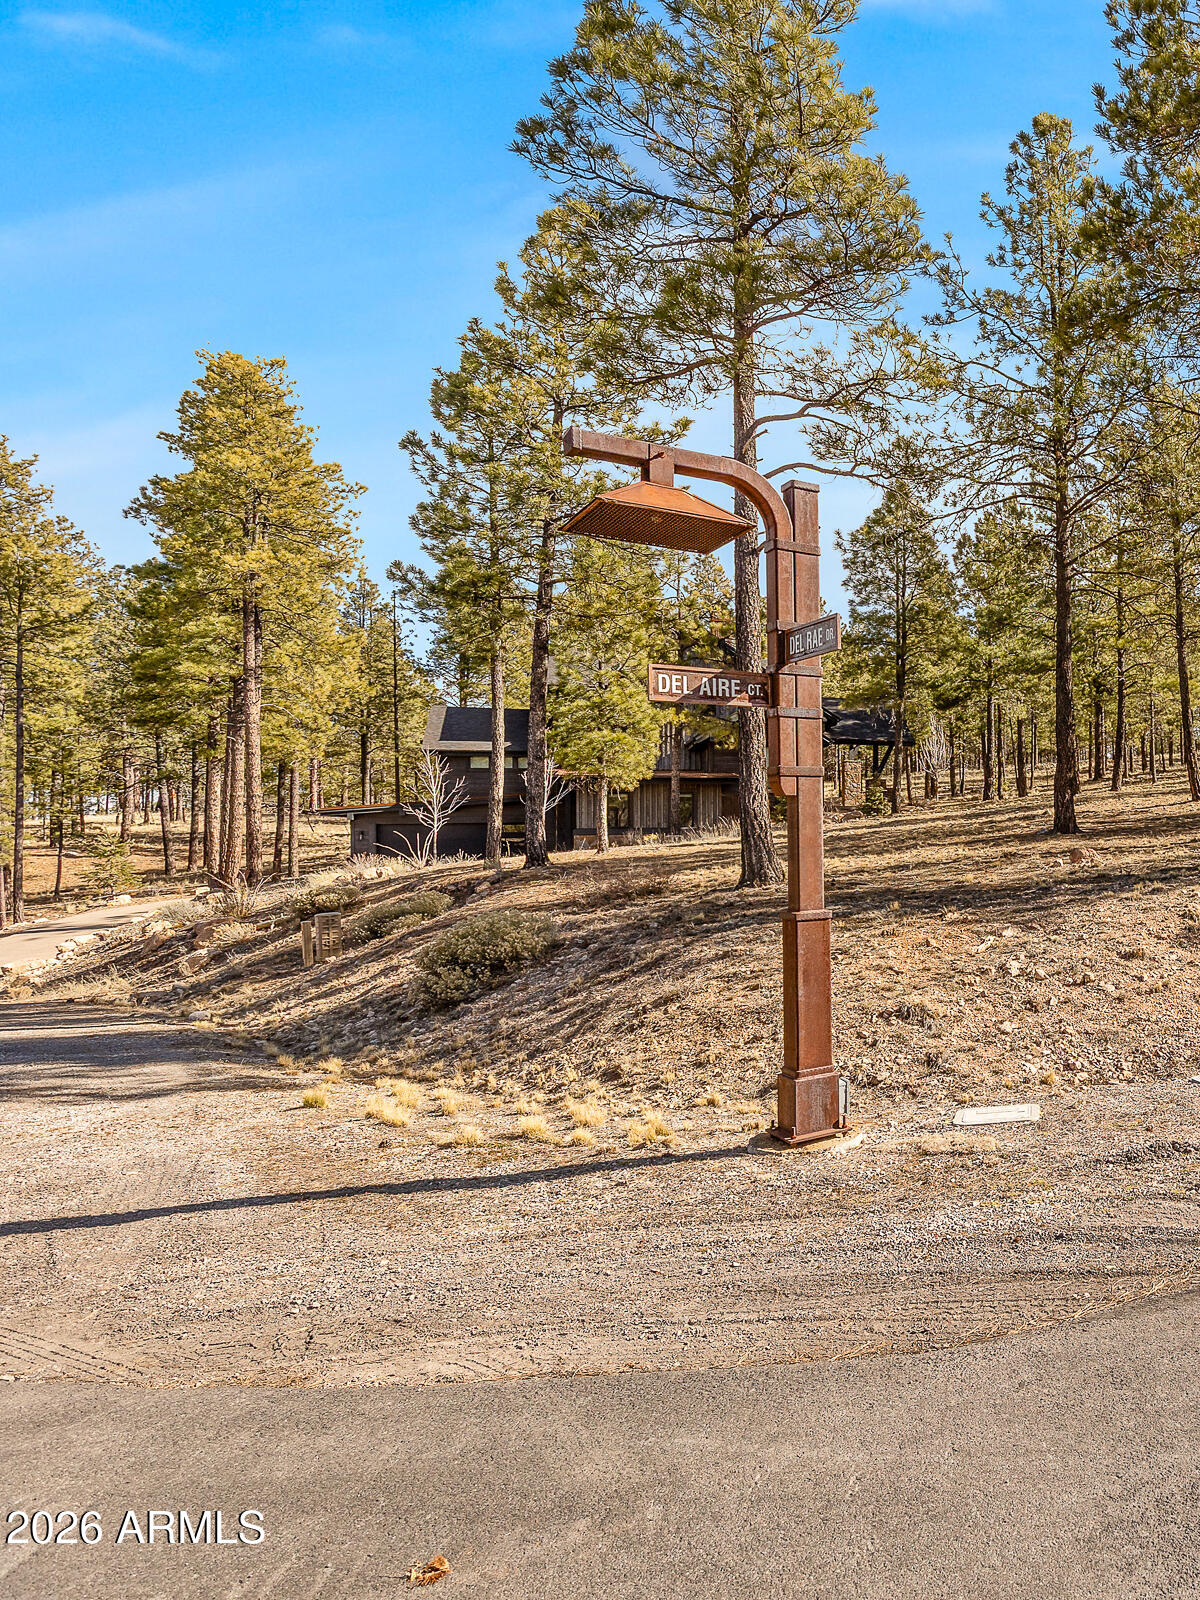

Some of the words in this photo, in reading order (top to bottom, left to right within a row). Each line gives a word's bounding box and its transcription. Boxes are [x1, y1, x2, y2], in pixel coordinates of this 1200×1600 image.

[789, 634, 804, 655] DEL
[806, 627, 823, 650] RAE
[825, 628, 836, 641] DR.
[657, 673, 693, 695] DEL
[699, 677, 741, 698] AIRE
[747, 684, 764, 697] CT.
